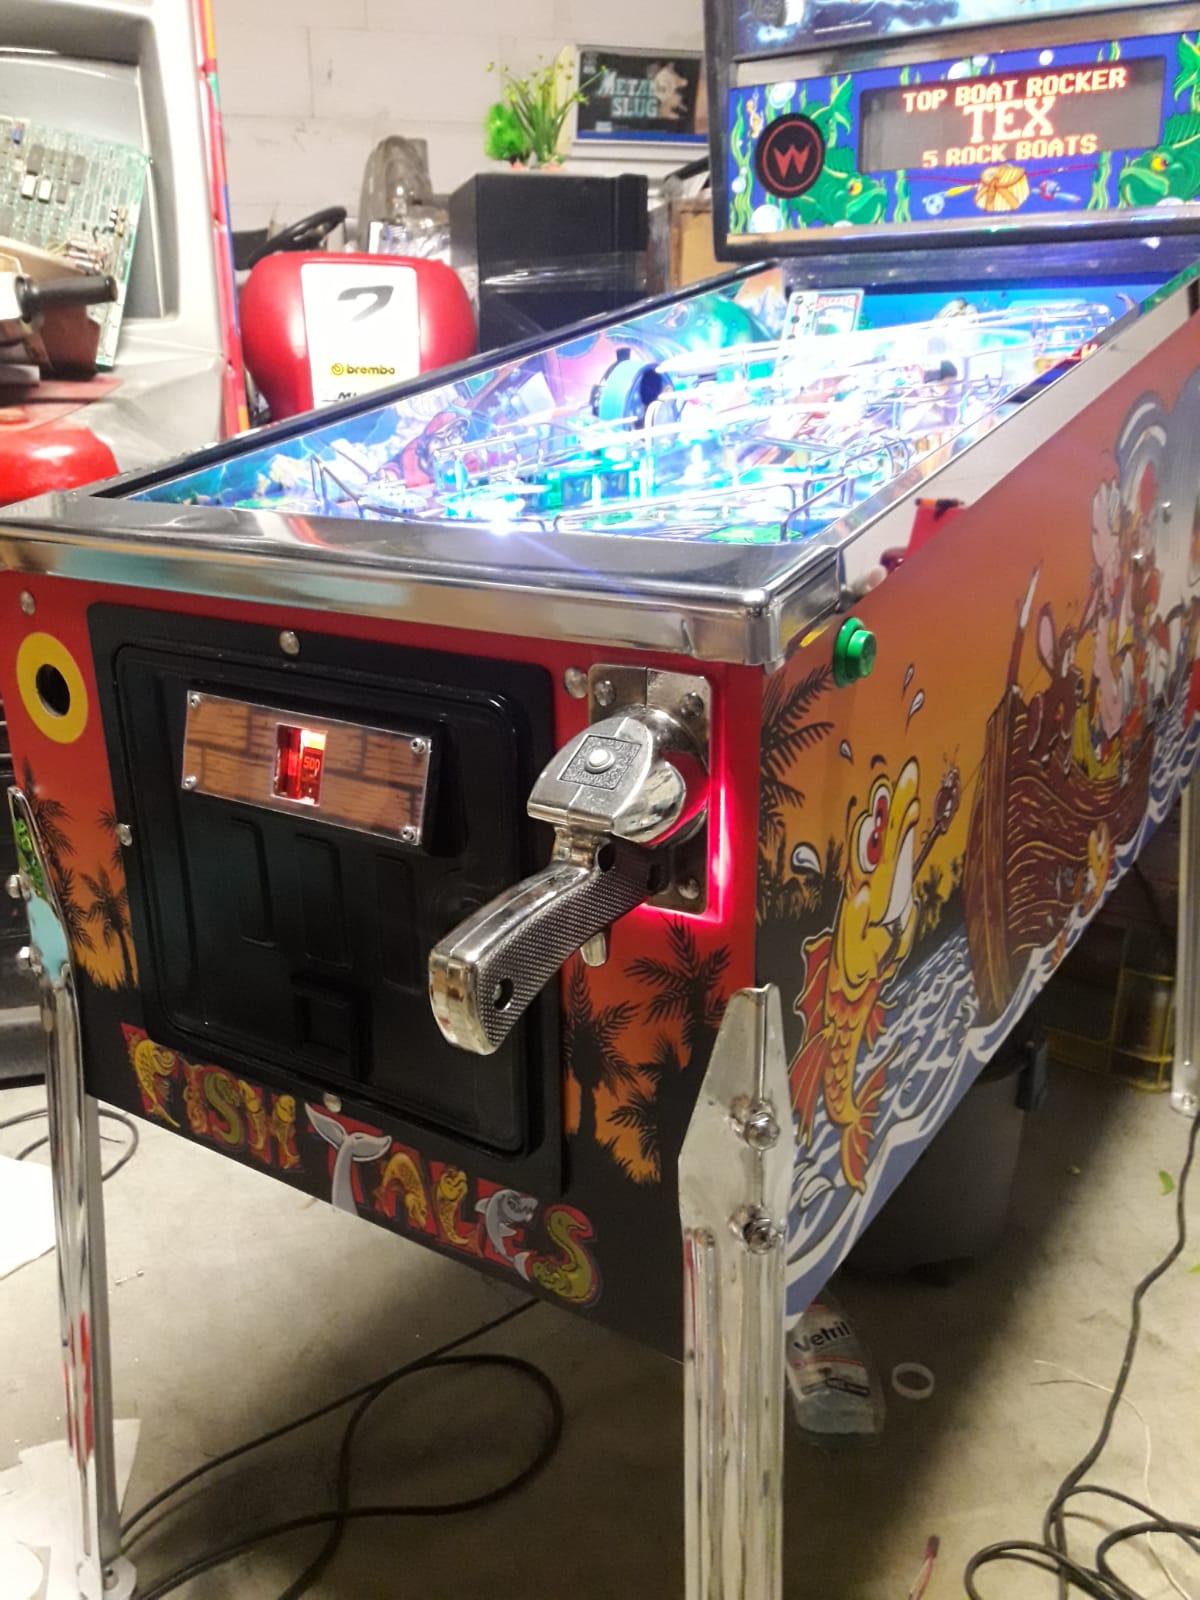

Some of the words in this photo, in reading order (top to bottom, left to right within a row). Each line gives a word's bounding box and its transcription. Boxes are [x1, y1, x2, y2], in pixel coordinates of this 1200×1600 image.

[612, 97, 658, 118] SLUG
[902, 89, 948, 113] TOP
[959, 80, 1018, 108] BOAT
[1029, 66, 1128, 98] ROCKER
[962, 95, 1058, 144] TEX
[922, 149, 940, 169] 5
[946, 141, 1008, 168] ROCK
[1016, 133, 1099, 160] BOATS
[346, 364, 396, 375] brembo
[121, 1022, 305, 1172] FISH
[304, 1102, 600, 1305] TALES
[793, 1321, 851, 1353] Vetril
